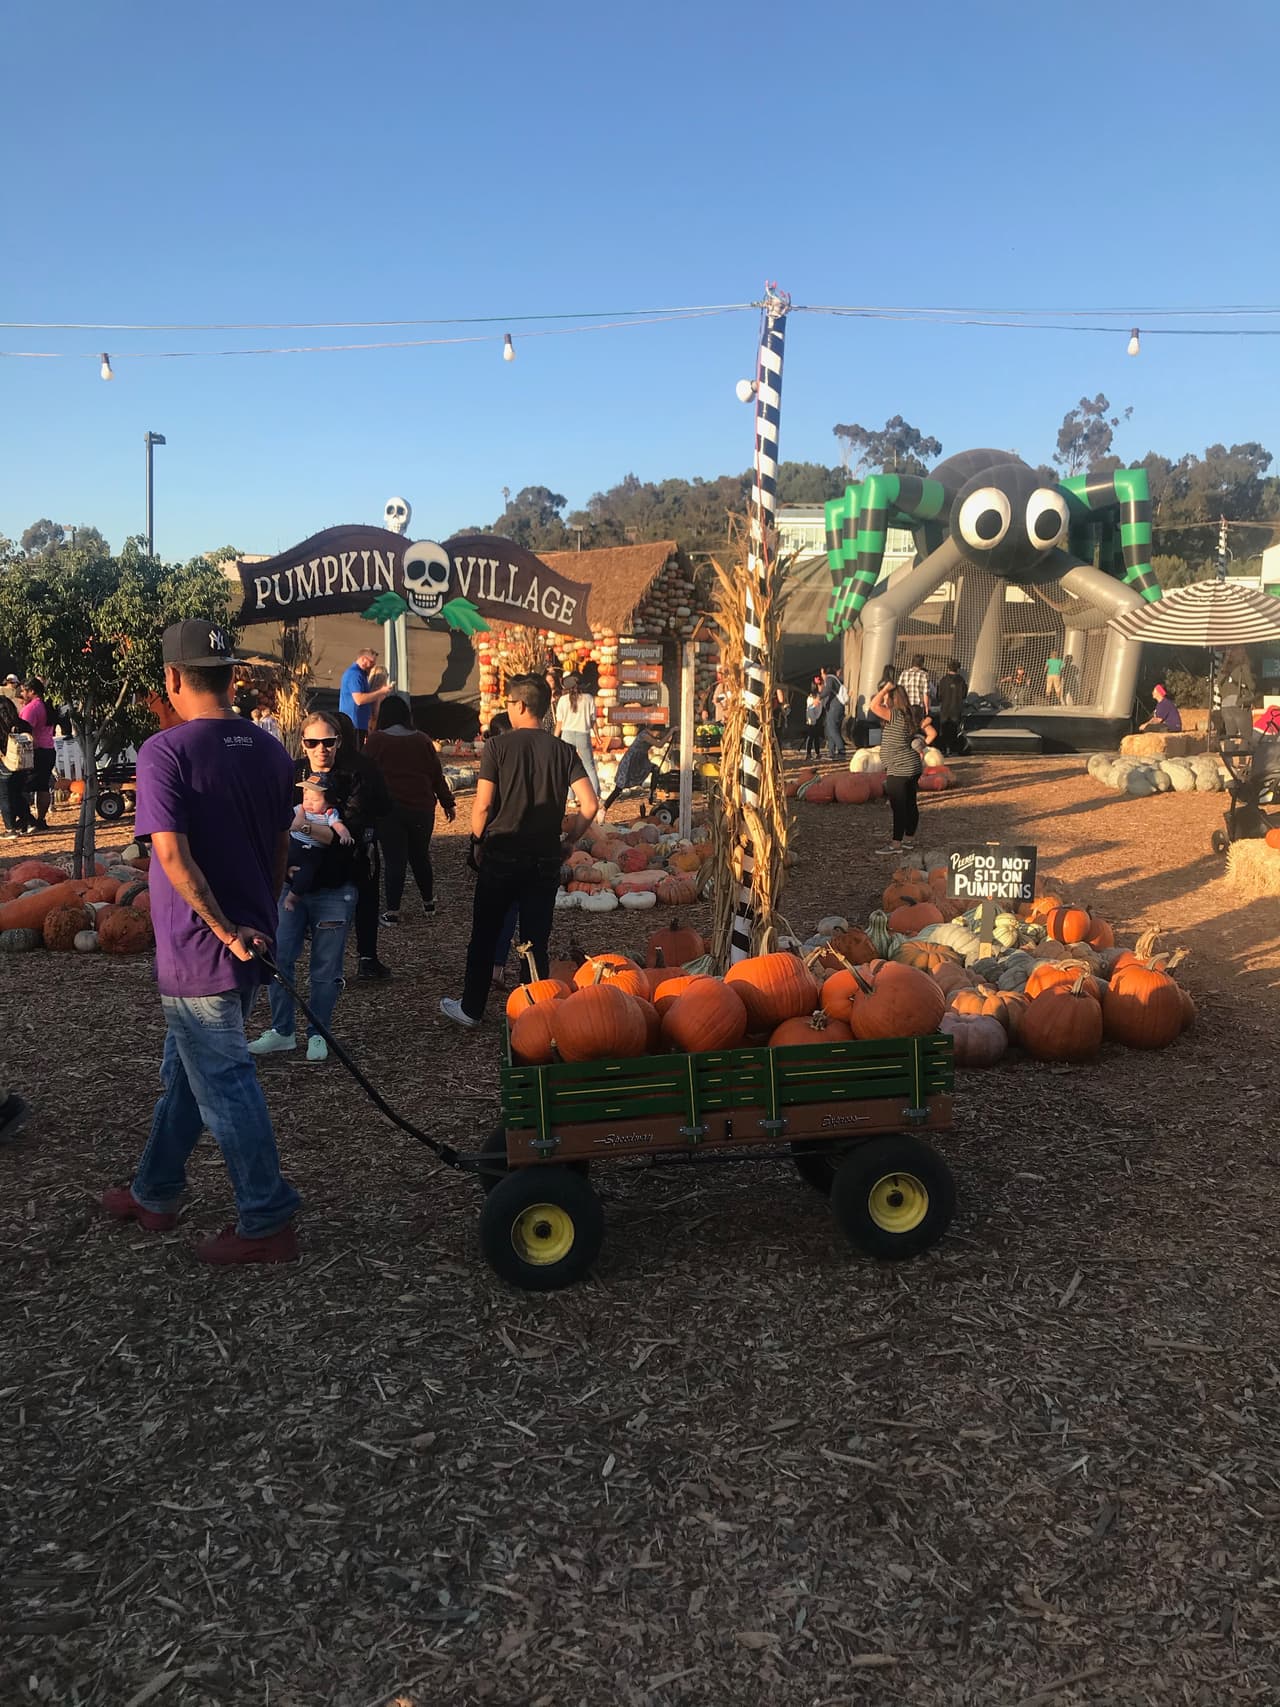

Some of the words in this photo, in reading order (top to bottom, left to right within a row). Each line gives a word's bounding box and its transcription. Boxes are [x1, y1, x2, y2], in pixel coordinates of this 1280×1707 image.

[254, 550, 395, 610] PUMPKIN
[453, 556, 577, 625] VILLAGE
[208, 630, 226, 650] NY
[974, 856, 995, 869] DO
[1002, 857, 1031, 870] NOT
[974, 869, 1000, 882] SIT
[1002, 870, 1023, 883] ON
[954, 873, 1032, 899] PUMPKINS
[603, 1131, 655, 1148] Speedway
